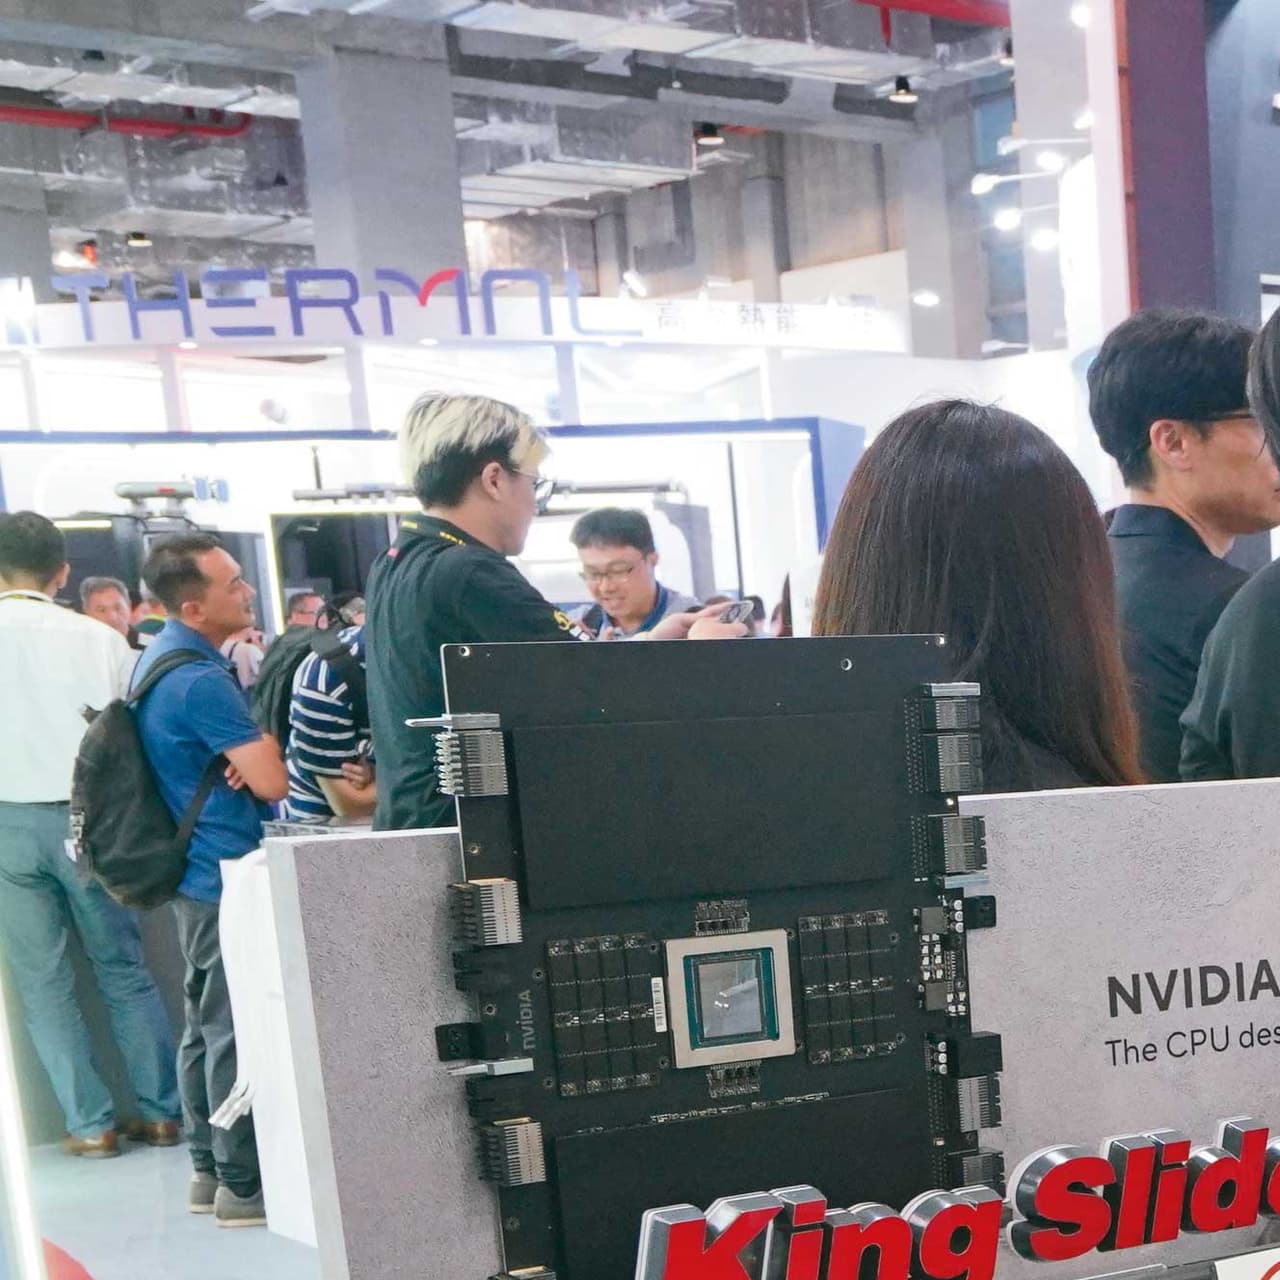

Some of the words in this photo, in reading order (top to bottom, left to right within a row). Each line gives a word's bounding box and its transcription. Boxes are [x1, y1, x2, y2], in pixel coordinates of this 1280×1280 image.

[518, 989, 537, 1051] NVIDIA
[1105, 1037, 1157, 1068] The
[1165, 1025, 1231, 1059] CPU
